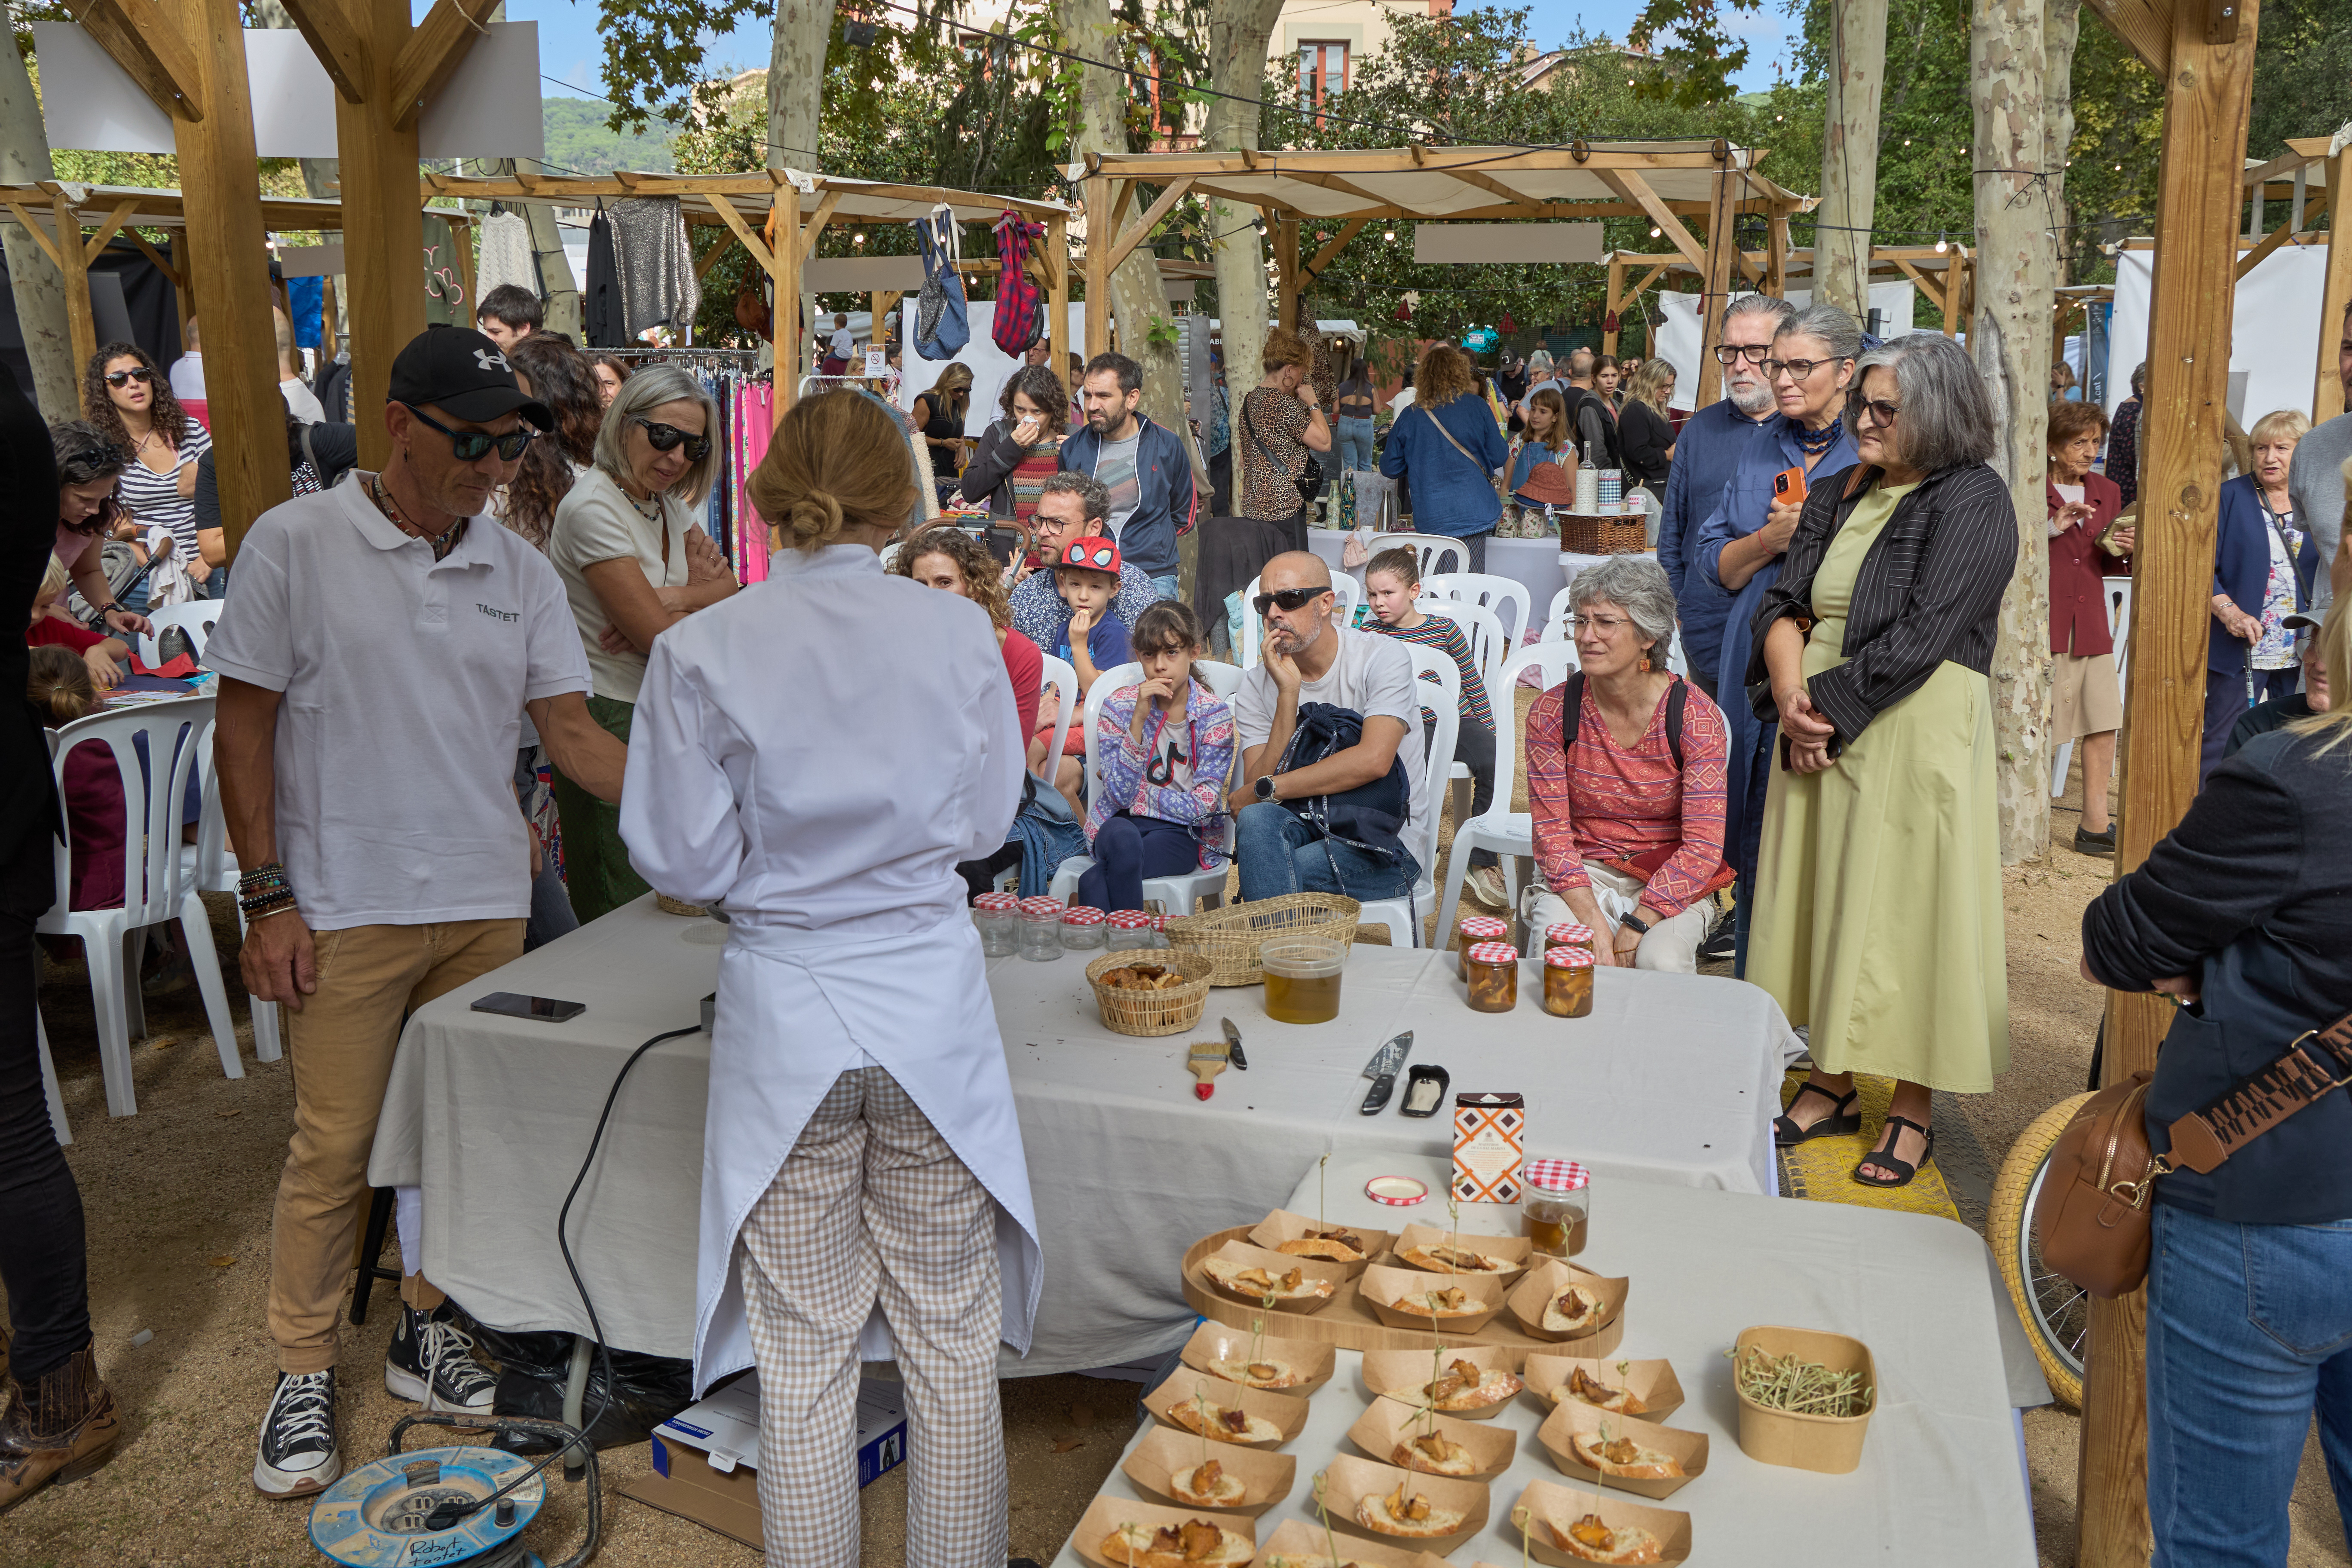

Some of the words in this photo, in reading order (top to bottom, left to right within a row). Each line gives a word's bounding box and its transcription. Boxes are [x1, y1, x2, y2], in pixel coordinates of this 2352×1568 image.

[476, 603, 520, 622] TASTET
[1192, 814, 1208, 824] SIUX
[1203, 844, 1223, 854] SIUX
[1344, 840, 1366, 848] SIUX
[1374, 847, 1393, 855] SIUX
[1329, 854, 1340, 875] SIUX
[410, 1537, 461, 1557] Robert
